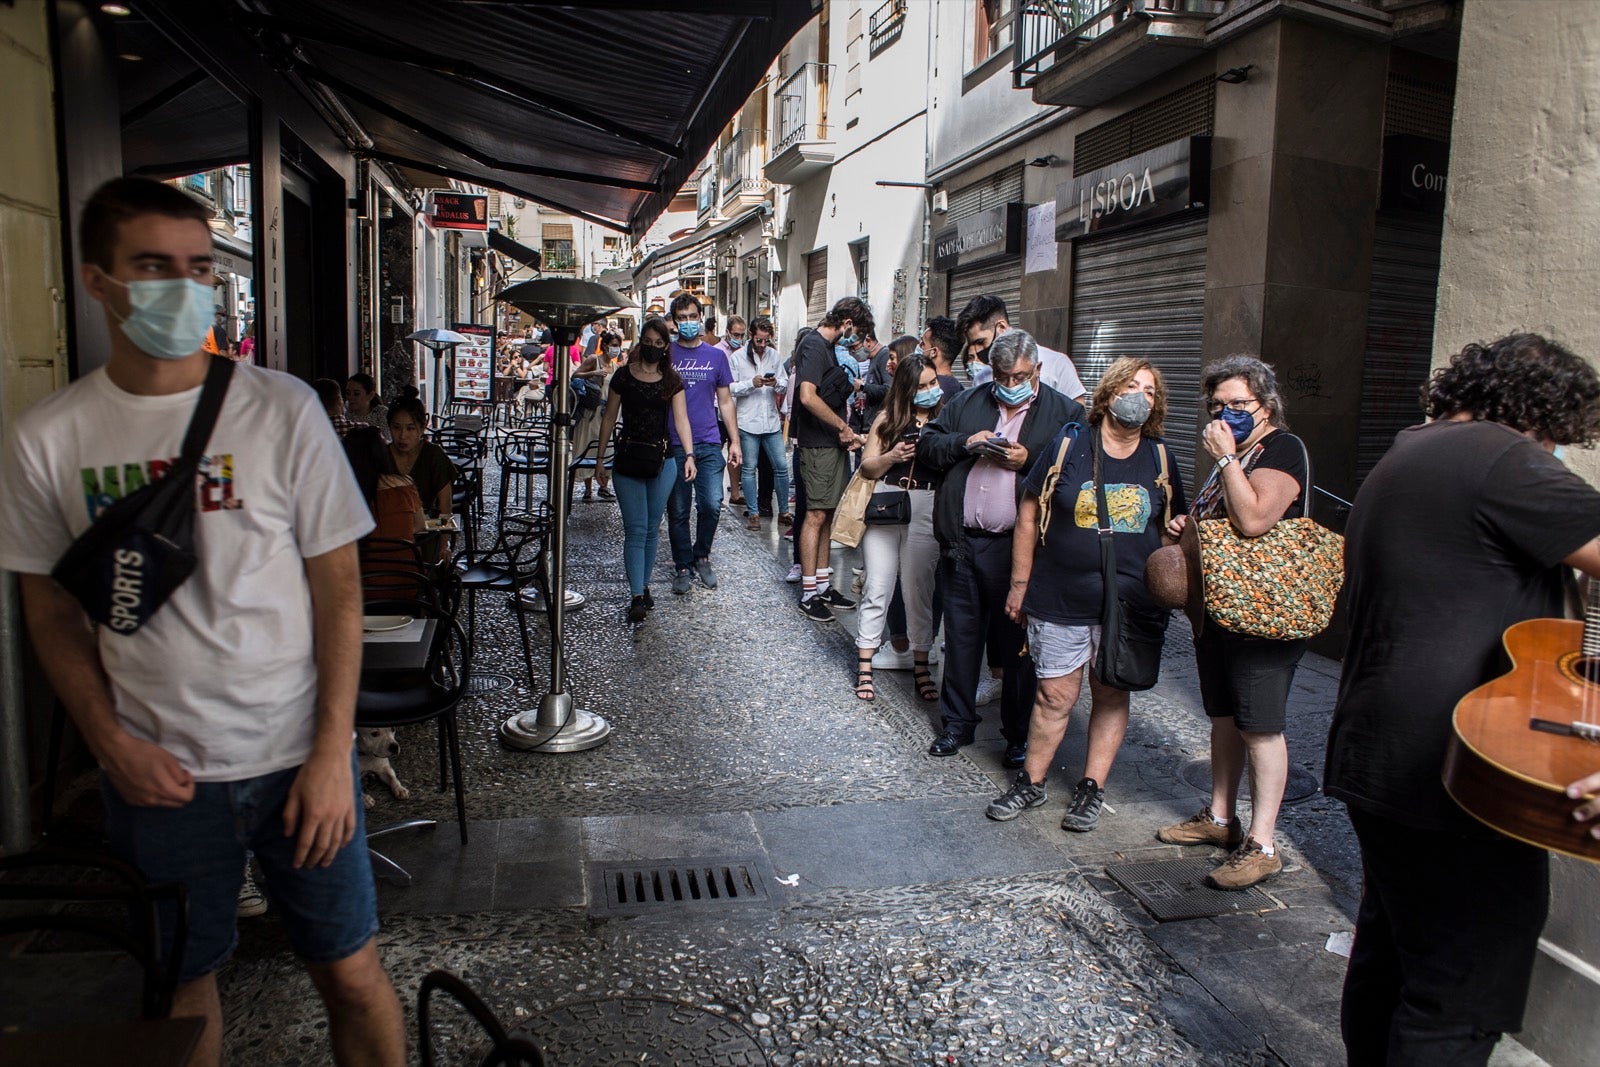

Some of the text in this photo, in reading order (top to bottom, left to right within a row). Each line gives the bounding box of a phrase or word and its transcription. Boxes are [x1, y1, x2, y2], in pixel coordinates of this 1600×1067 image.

[1080, 167, 1156, 222] LISBOA
[936, 236, 965, 259] ASADERO
[110, 549, 144, 629] SPORTS
